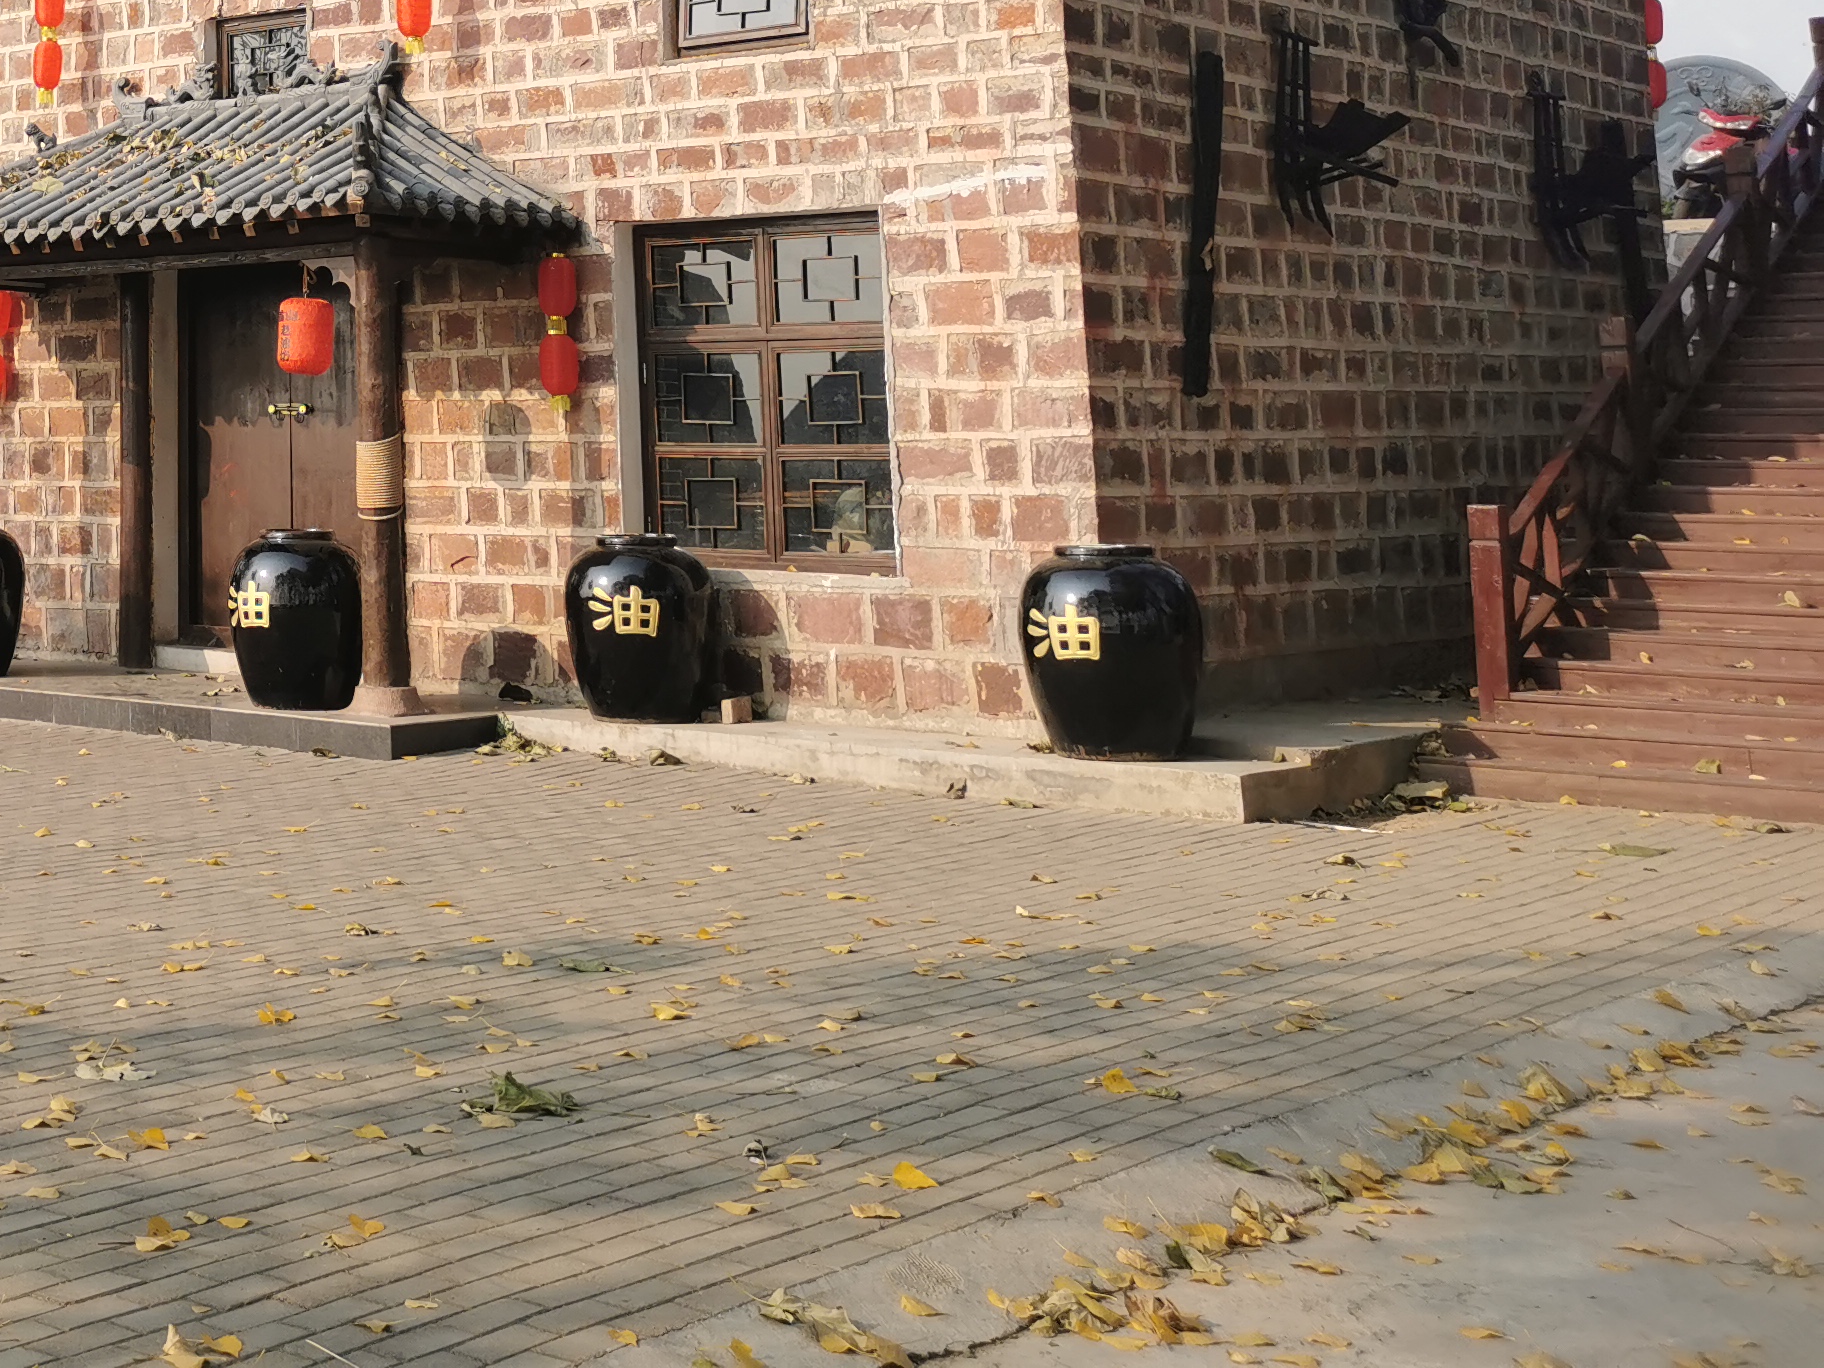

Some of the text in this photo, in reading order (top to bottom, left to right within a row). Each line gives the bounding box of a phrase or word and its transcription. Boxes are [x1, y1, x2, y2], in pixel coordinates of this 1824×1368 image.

[227, 580, 270, 629] 油
[588, 585, 660, 638] 油
[1027, 604, 1101, 661] 油
